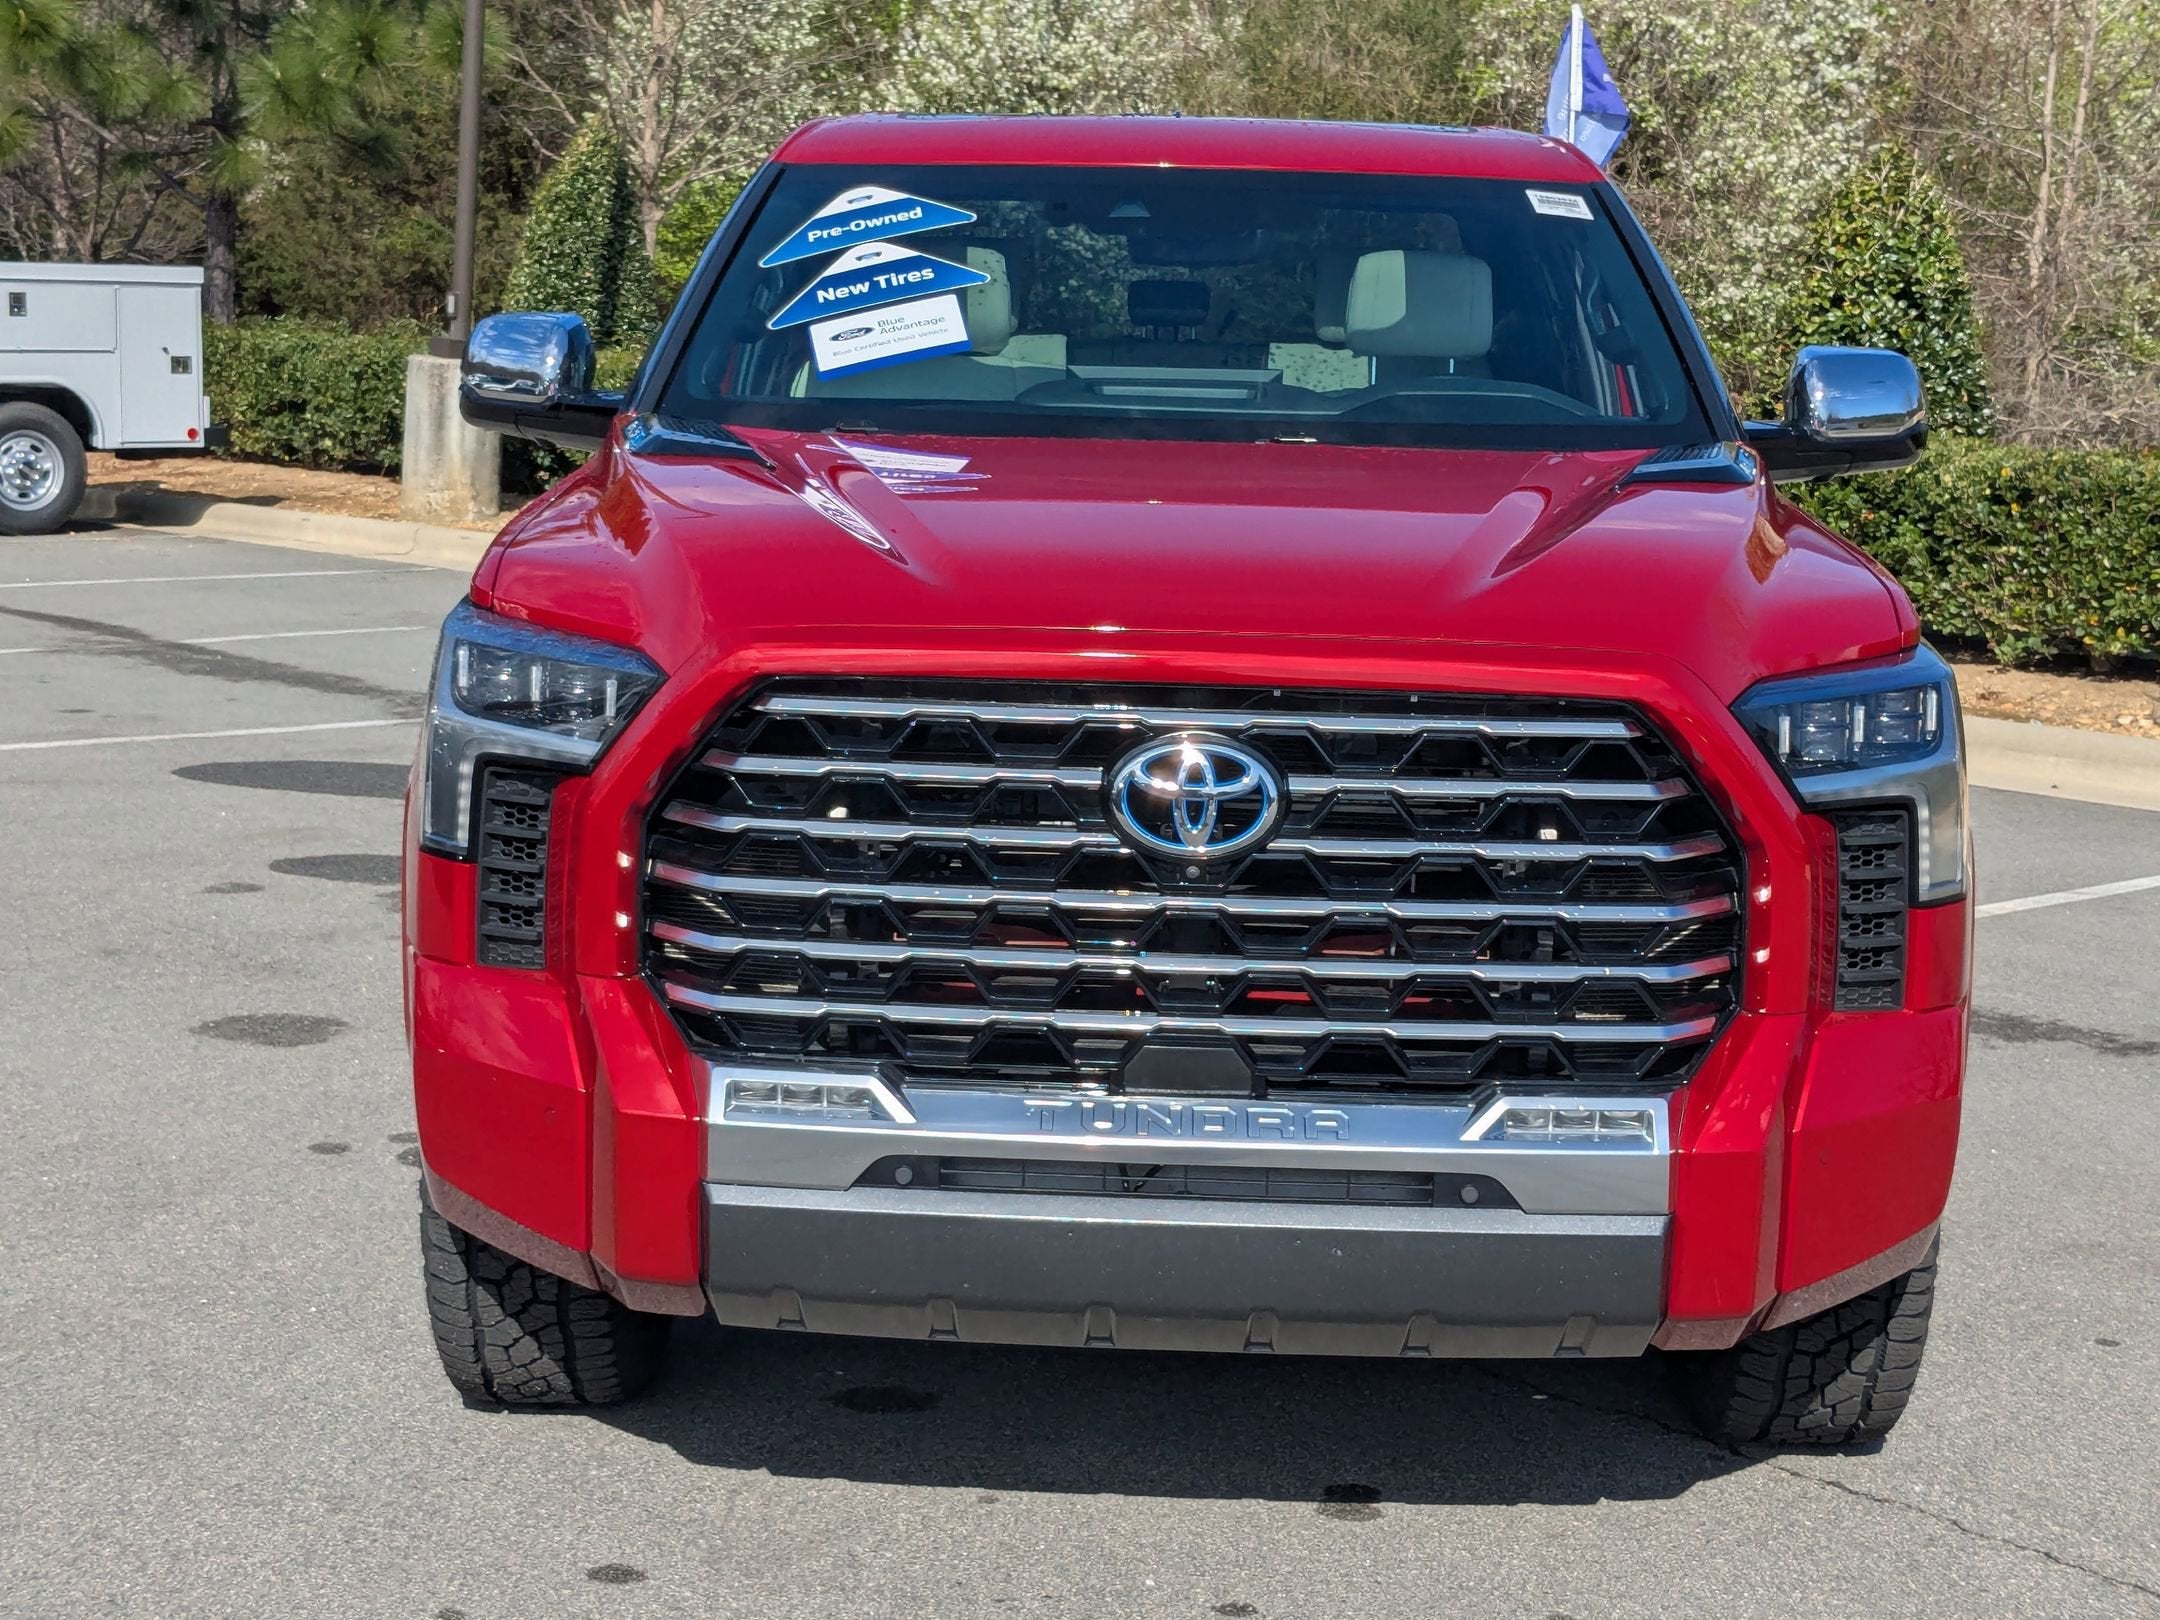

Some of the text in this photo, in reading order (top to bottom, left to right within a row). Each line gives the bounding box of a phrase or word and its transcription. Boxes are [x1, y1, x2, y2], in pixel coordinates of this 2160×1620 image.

[807, 206, 923, 242] Pre-Owned
[816, 268, 935, 304] New Tires
[877, 317, 905, 328] Blue
[879, 316, 945, 335] Advantage
[1023, 1099, 1350, 1141] TUNDRA
